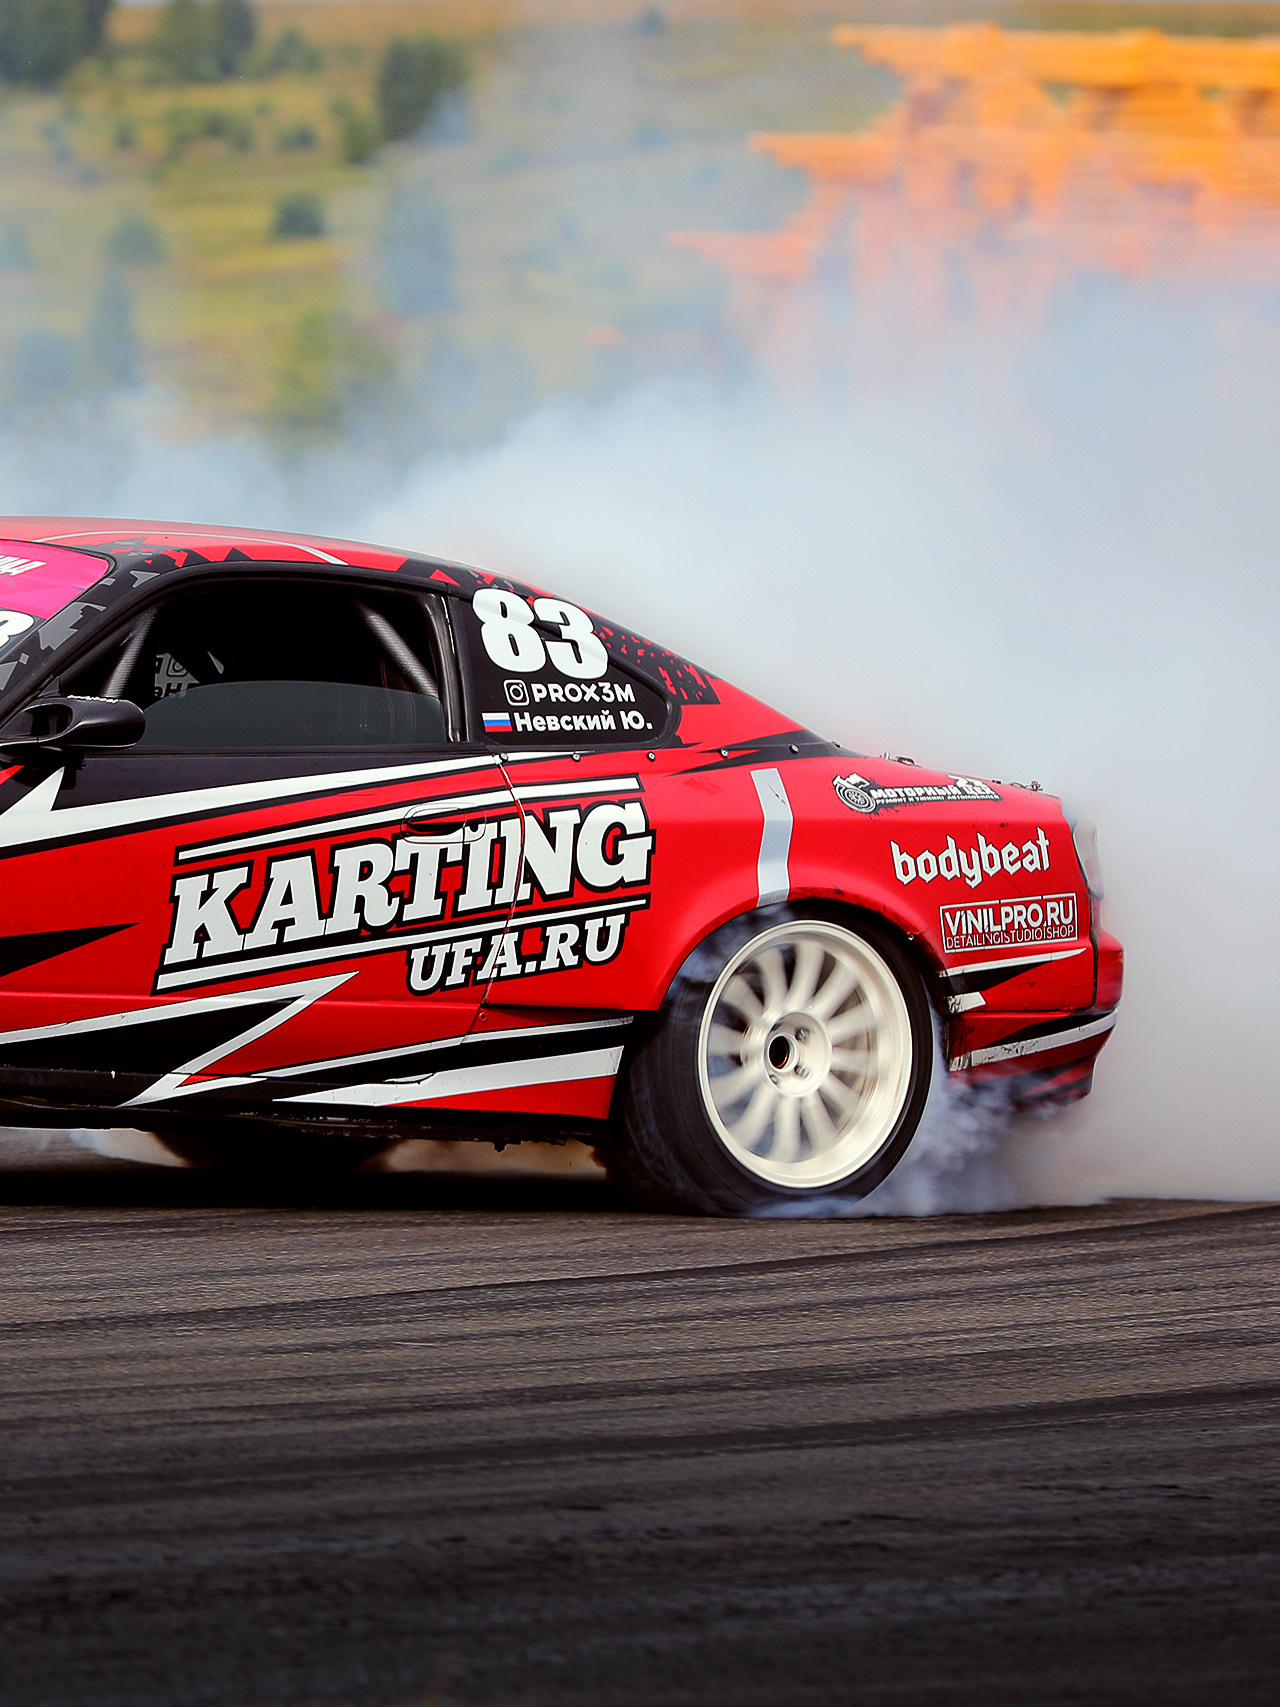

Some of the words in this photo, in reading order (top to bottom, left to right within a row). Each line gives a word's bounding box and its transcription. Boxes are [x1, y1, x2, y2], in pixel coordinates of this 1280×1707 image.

[472, 588, 609, 680] 83
[532, 682, 636, 704] PROX3M
[513, 709, 617, 733] Невский
[621, 710, 654, 731] Ю.
[870, 784, 962, 800] МОТОРНЫЙ
[890, 827, 1051, 888] bodybeat
[164, 801, 654, 966] KARTING
[944, 899, 1074, 937] VINILPRO.RU
[408, 913, 628, 993] UFA.RU
